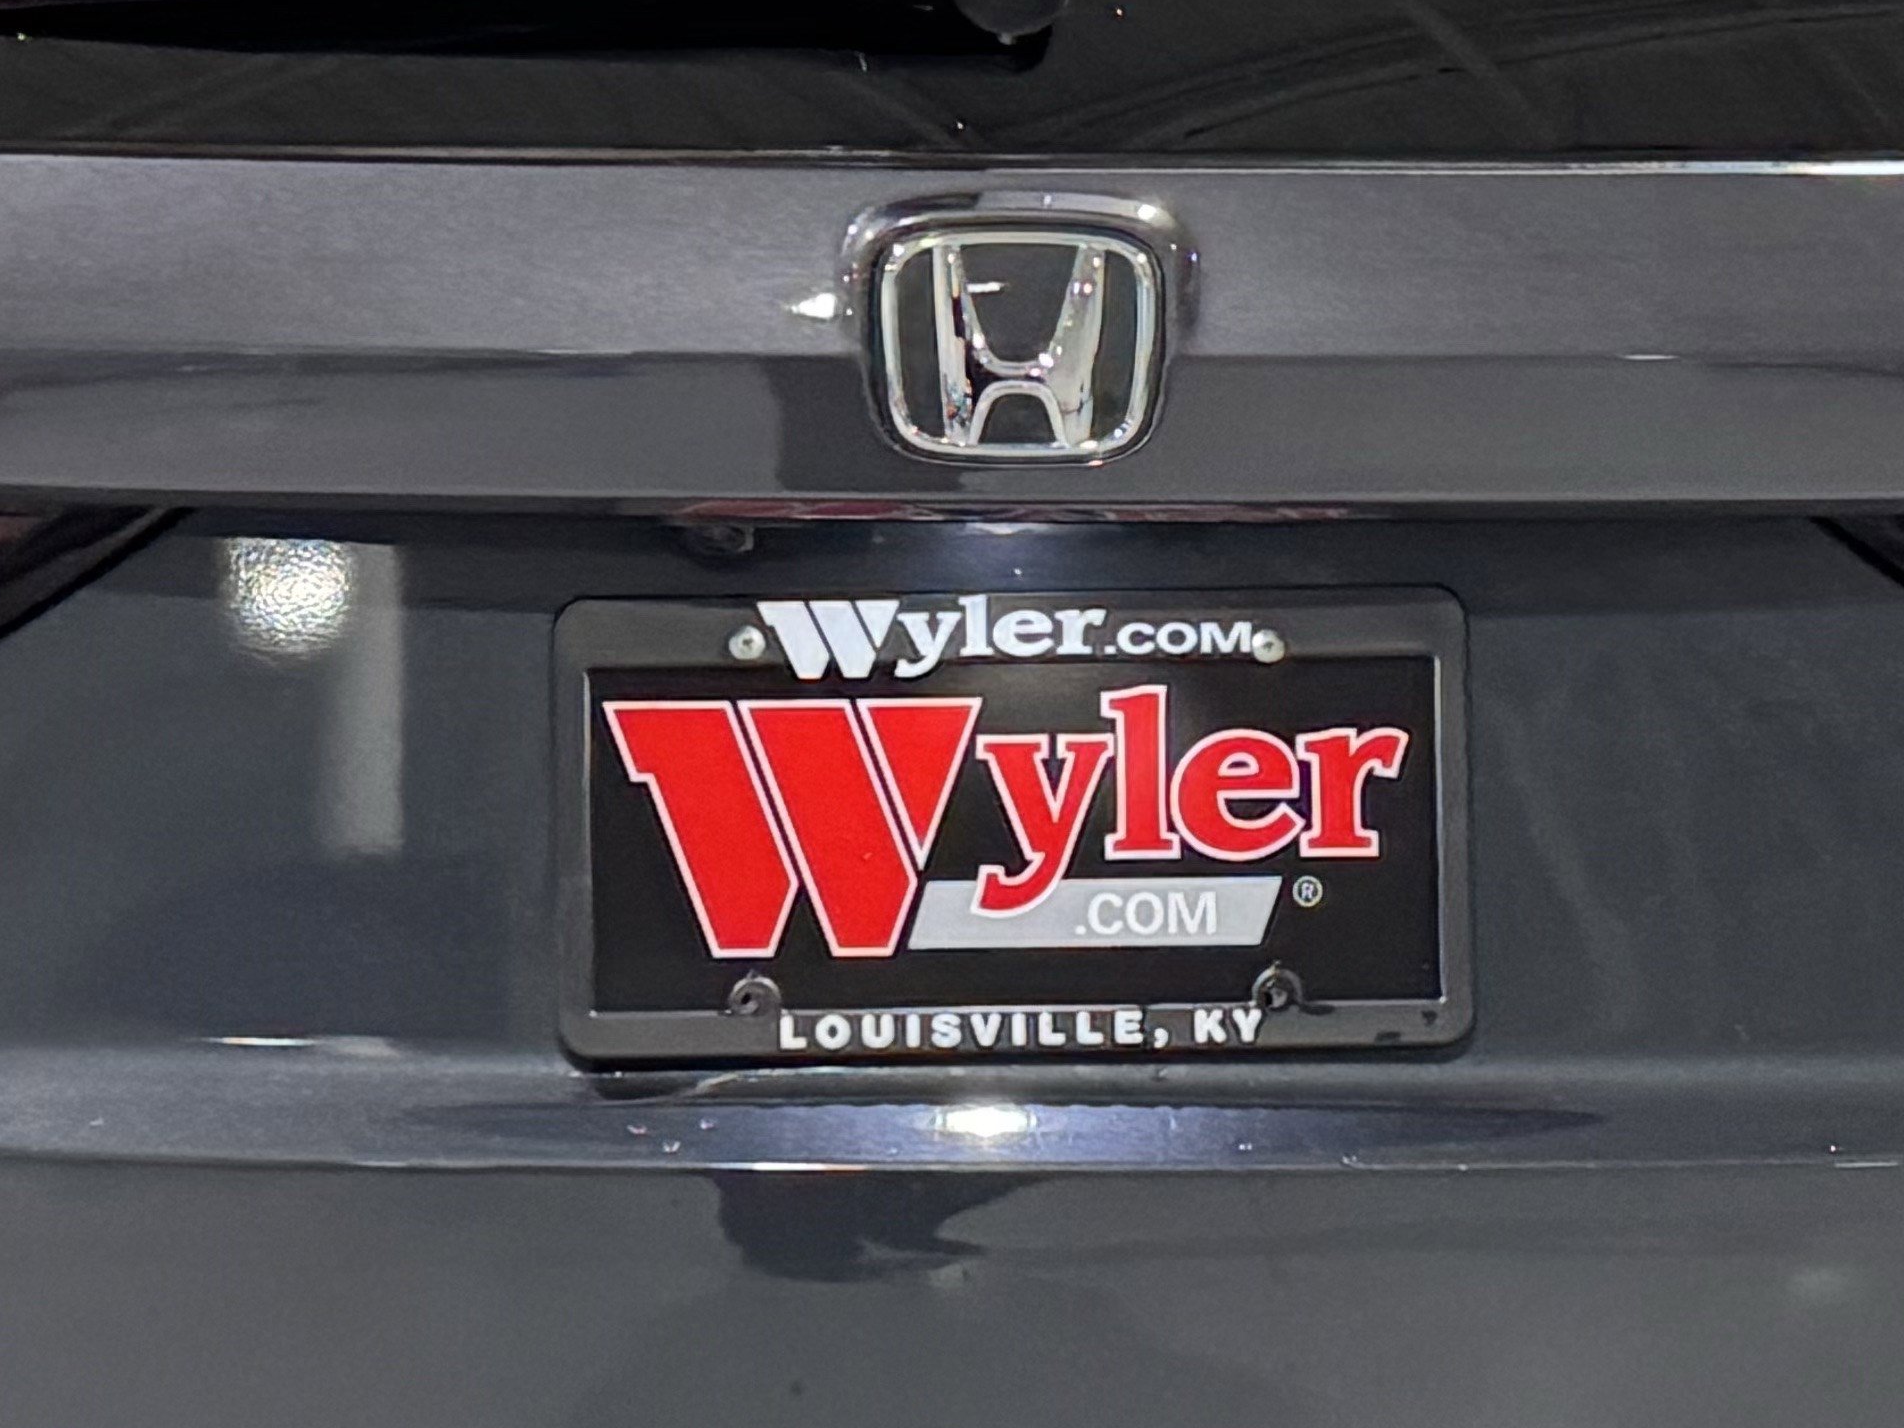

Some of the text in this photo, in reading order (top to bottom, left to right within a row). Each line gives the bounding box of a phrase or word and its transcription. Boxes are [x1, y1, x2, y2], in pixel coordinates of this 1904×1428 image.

[602, 684, 1410, 959] Wyler
[1074, 890, 1218, 936] .COM
[778, 1010, 1265, 1051] LOUISVILLE, KY
